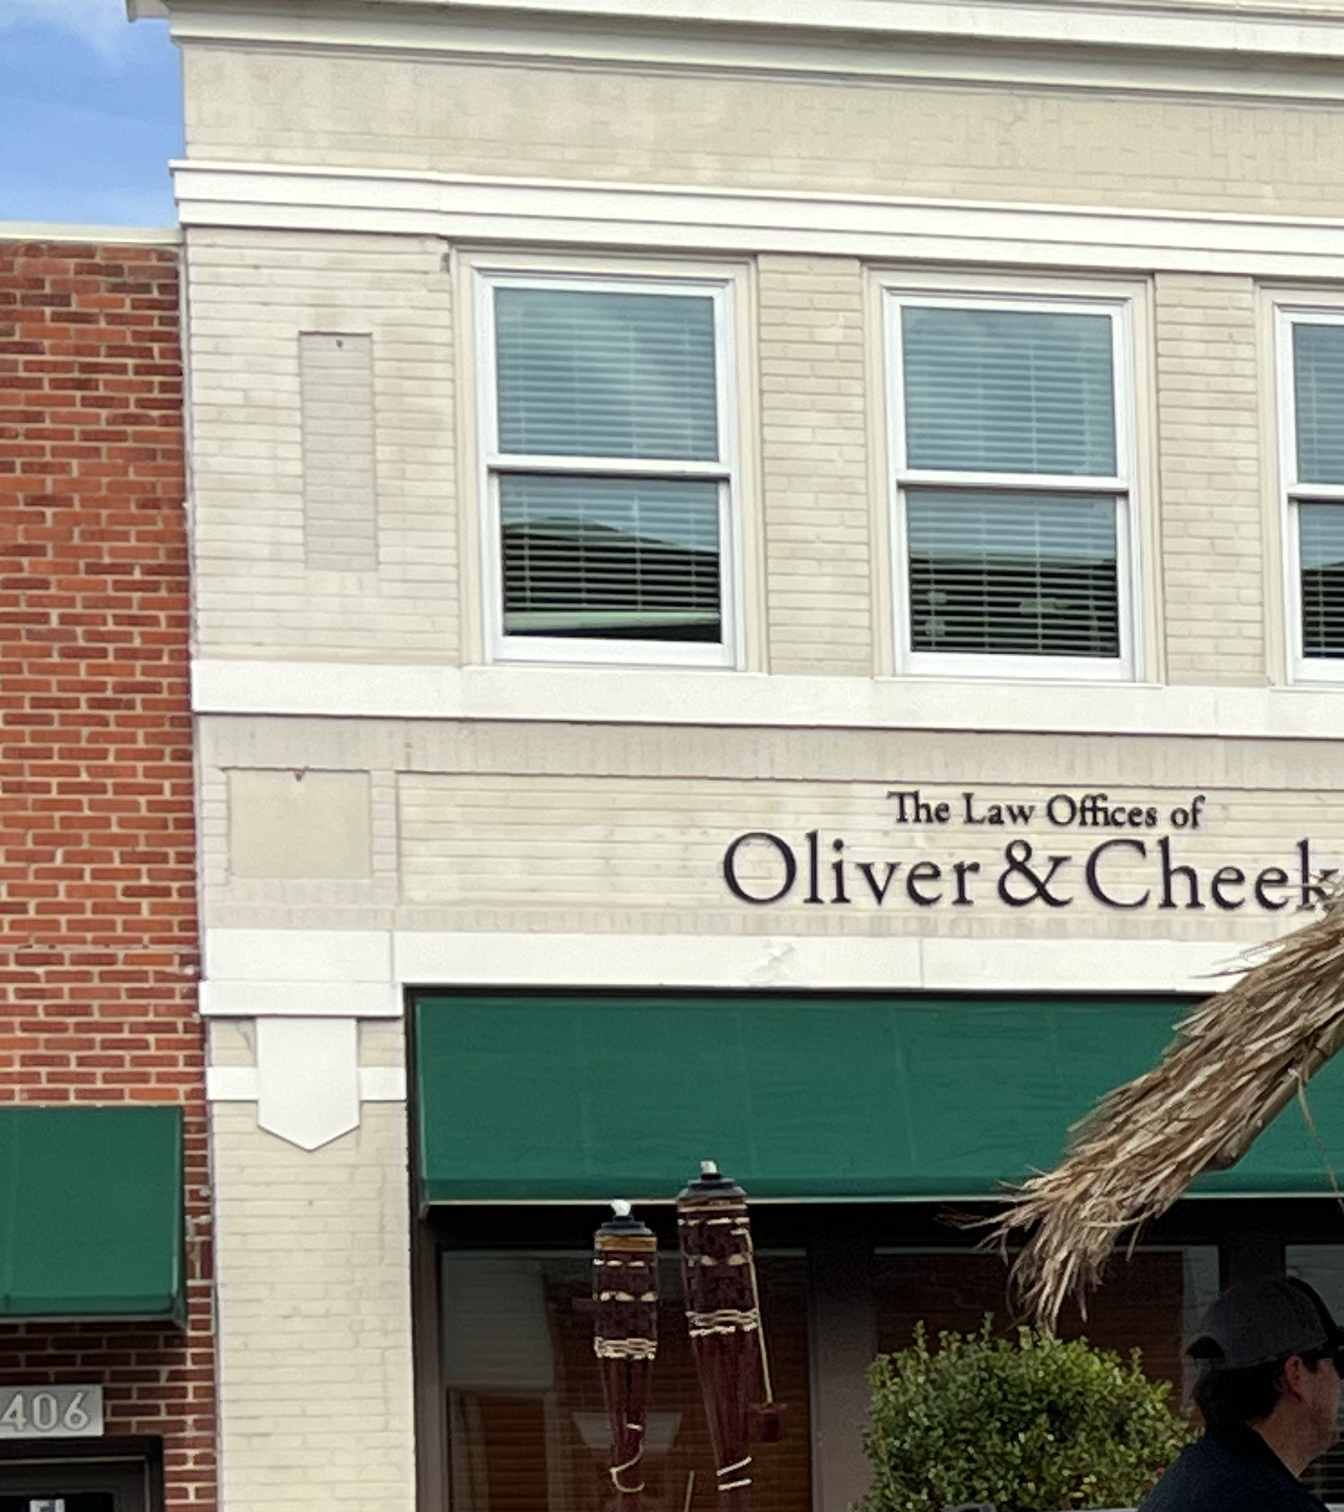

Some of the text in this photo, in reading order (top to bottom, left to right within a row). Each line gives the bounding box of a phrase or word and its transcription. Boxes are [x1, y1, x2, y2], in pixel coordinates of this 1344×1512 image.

[887, 790, 1206, 829] The Law Offices of
[723, 829, 981, 905] Oliver
[1, 1391, 90, 1431] 406
